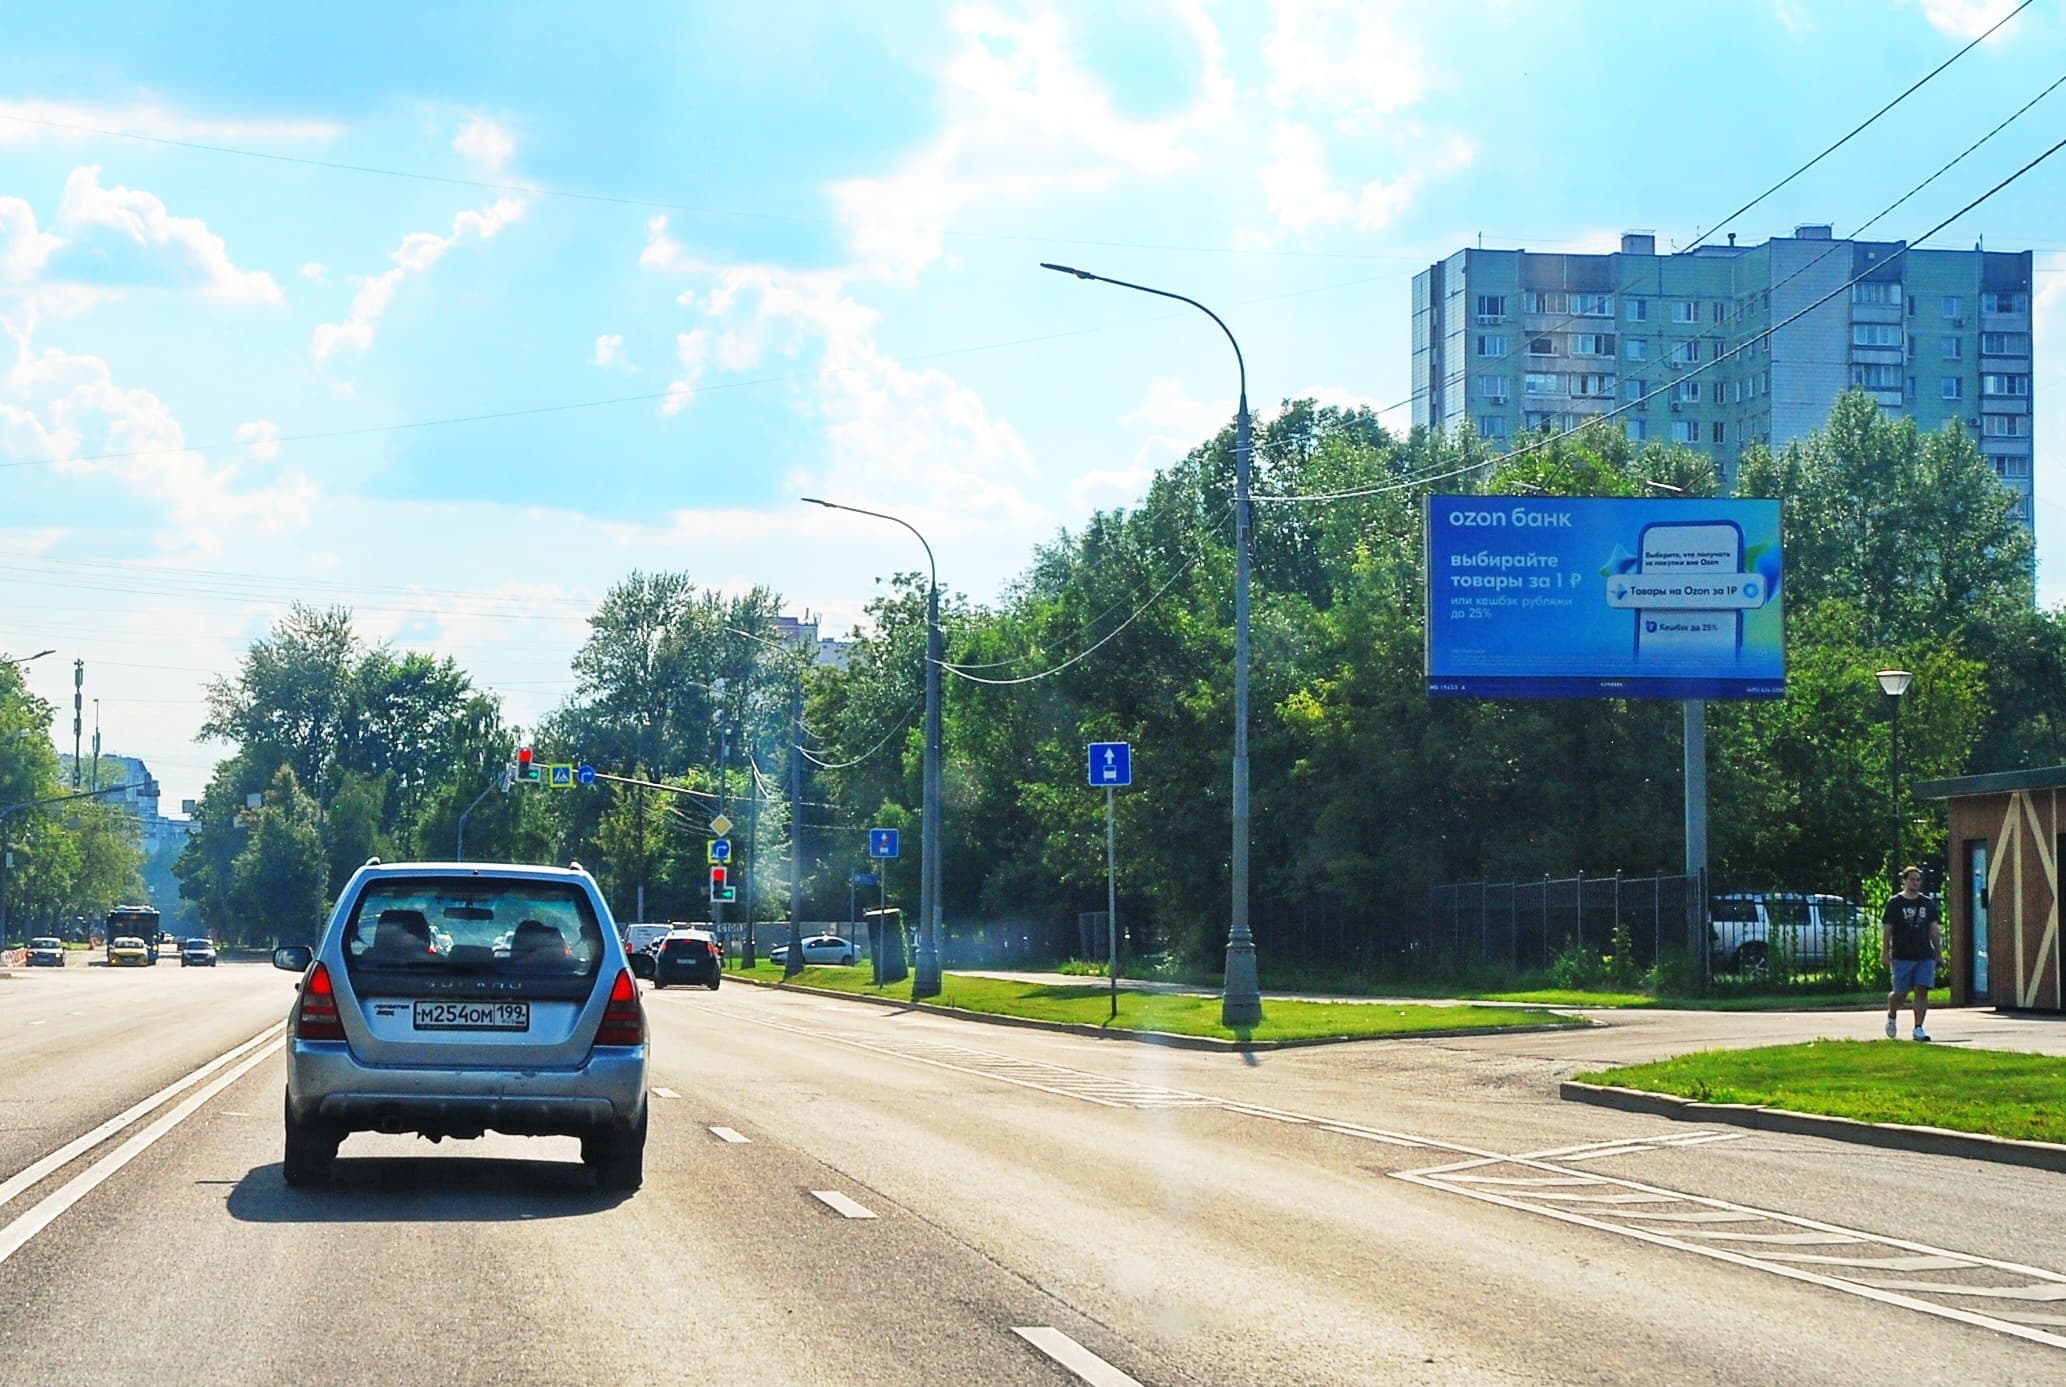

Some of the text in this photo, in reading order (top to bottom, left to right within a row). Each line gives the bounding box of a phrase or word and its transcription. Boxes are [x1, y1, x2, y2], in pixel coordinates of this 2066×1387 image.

[1449, 507, 1572, 527] ozon банк
[1450, 550, 1559, 571] выбирайте
[1450, 575, 1523, 591] товары
[1529, 576, 1551, 588] за
[1556, 572, 1562, 588] 1
[1630, 586, 1667, 598] Товары
[1684, 586, 1710, 596] Ozon
[1450, 608, 1493, 619] до 25%
[496, 1006, 523, 1019] 199
